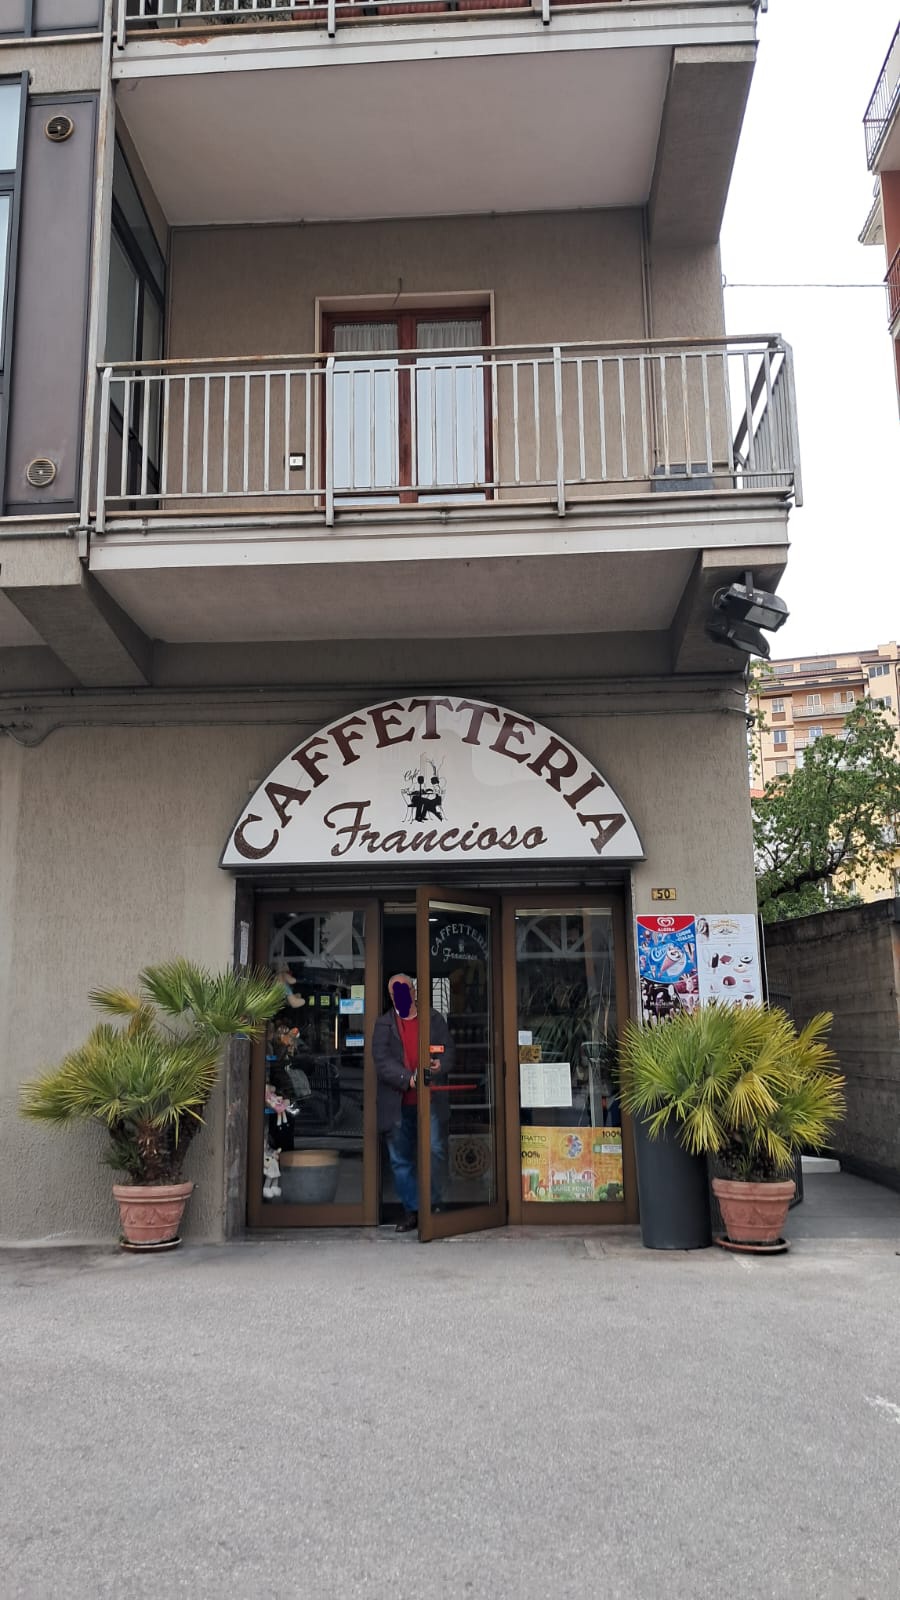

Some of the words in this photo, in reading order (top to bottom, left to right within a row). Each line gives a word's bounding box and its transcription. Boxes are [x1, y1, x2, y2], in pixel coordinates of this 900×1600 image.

[233, 697, 627, 860] CAFFETTERIA
[323, 800, 548, 857] Francioso
[657, 888, 671, 899] 50
